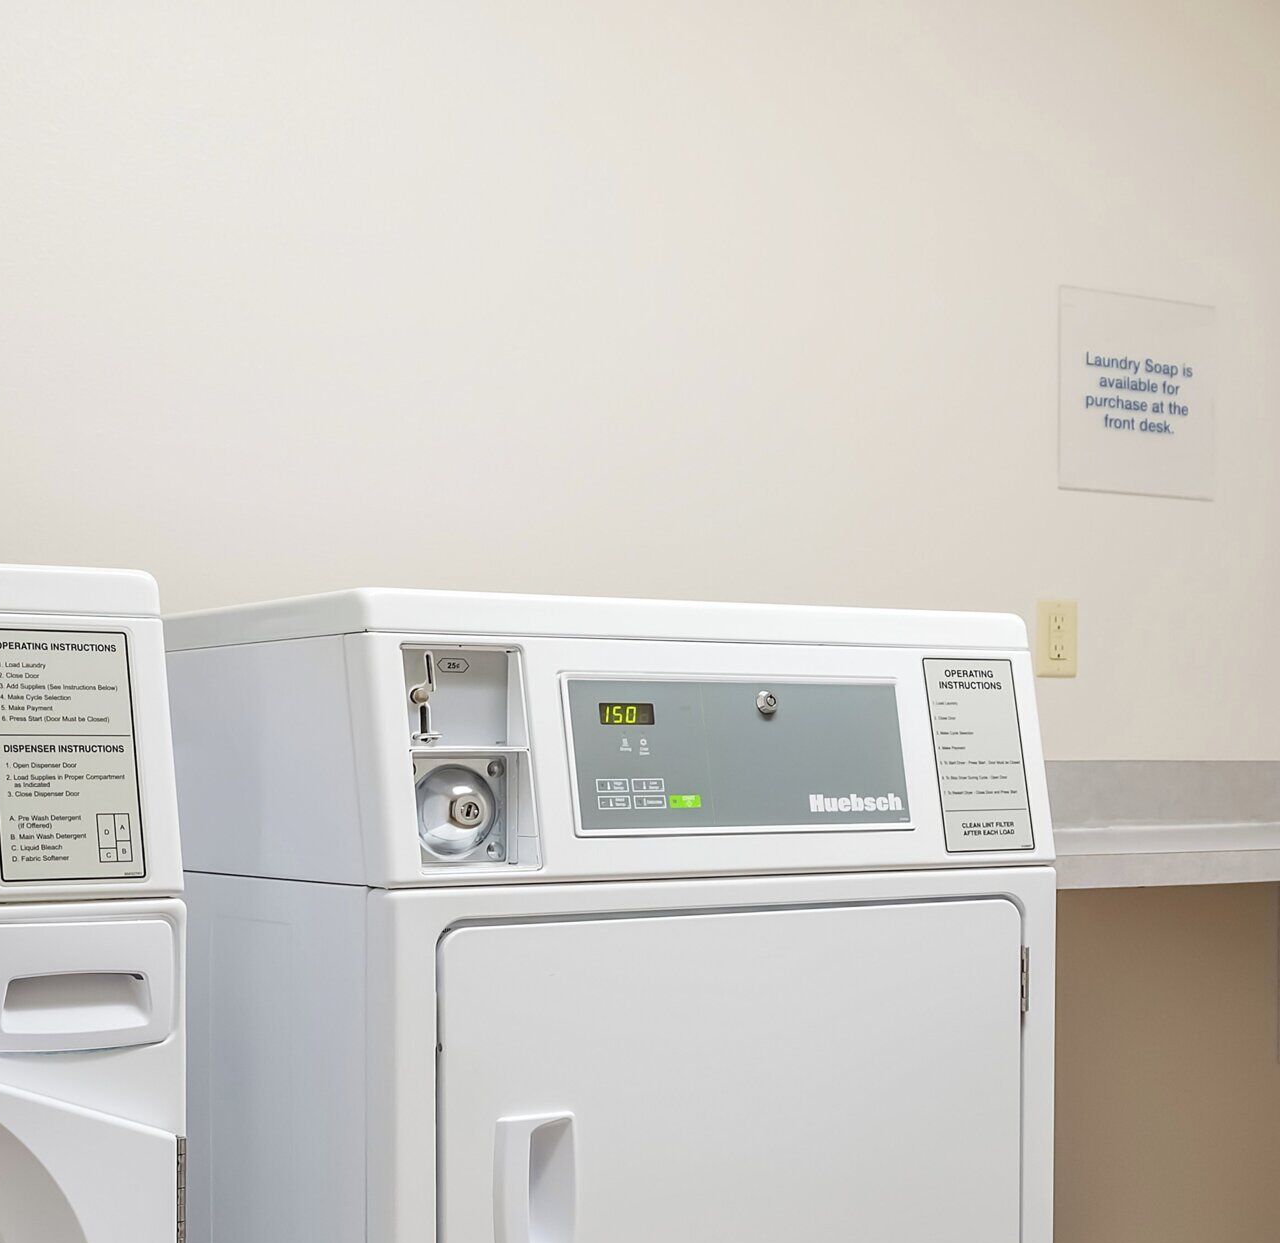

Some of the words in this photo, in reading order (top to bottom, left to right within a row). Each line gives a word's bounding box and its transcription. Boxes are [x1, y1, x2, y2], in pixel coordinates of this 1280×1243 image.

[1086, 351, 1140, 375] Laundry
[1145, 358, 1179, 378] Soap
[1183, 363, 1193, 378] is
[1099, 376, 1158, 393] available
[1162, 380, 1180, 395] for
[1085, 394, 1148, 412] purchase
[1152, 401, 1164, 414] at
[1168, 401, 1189, 416] the
[1104, 414, 1135, 430] front
[1139, 418, 1174, 435] desk.
[50, 643, 117, 653] INSTRUCTIONS
[944, 669, 994, 678] OPERATING
[20, 683, 46, 691] Supplies
[938, 681, 1002, 690] INSTRUCTIONS
[26, 694, 42, 702] Cycle
[605, 705, 637, 723] 150
[3, 744, 56, 753] DISPENSER
[58, 744, 125, 753] INSTRUCTIONS
[809, 793, 903, 812] Huebsch
